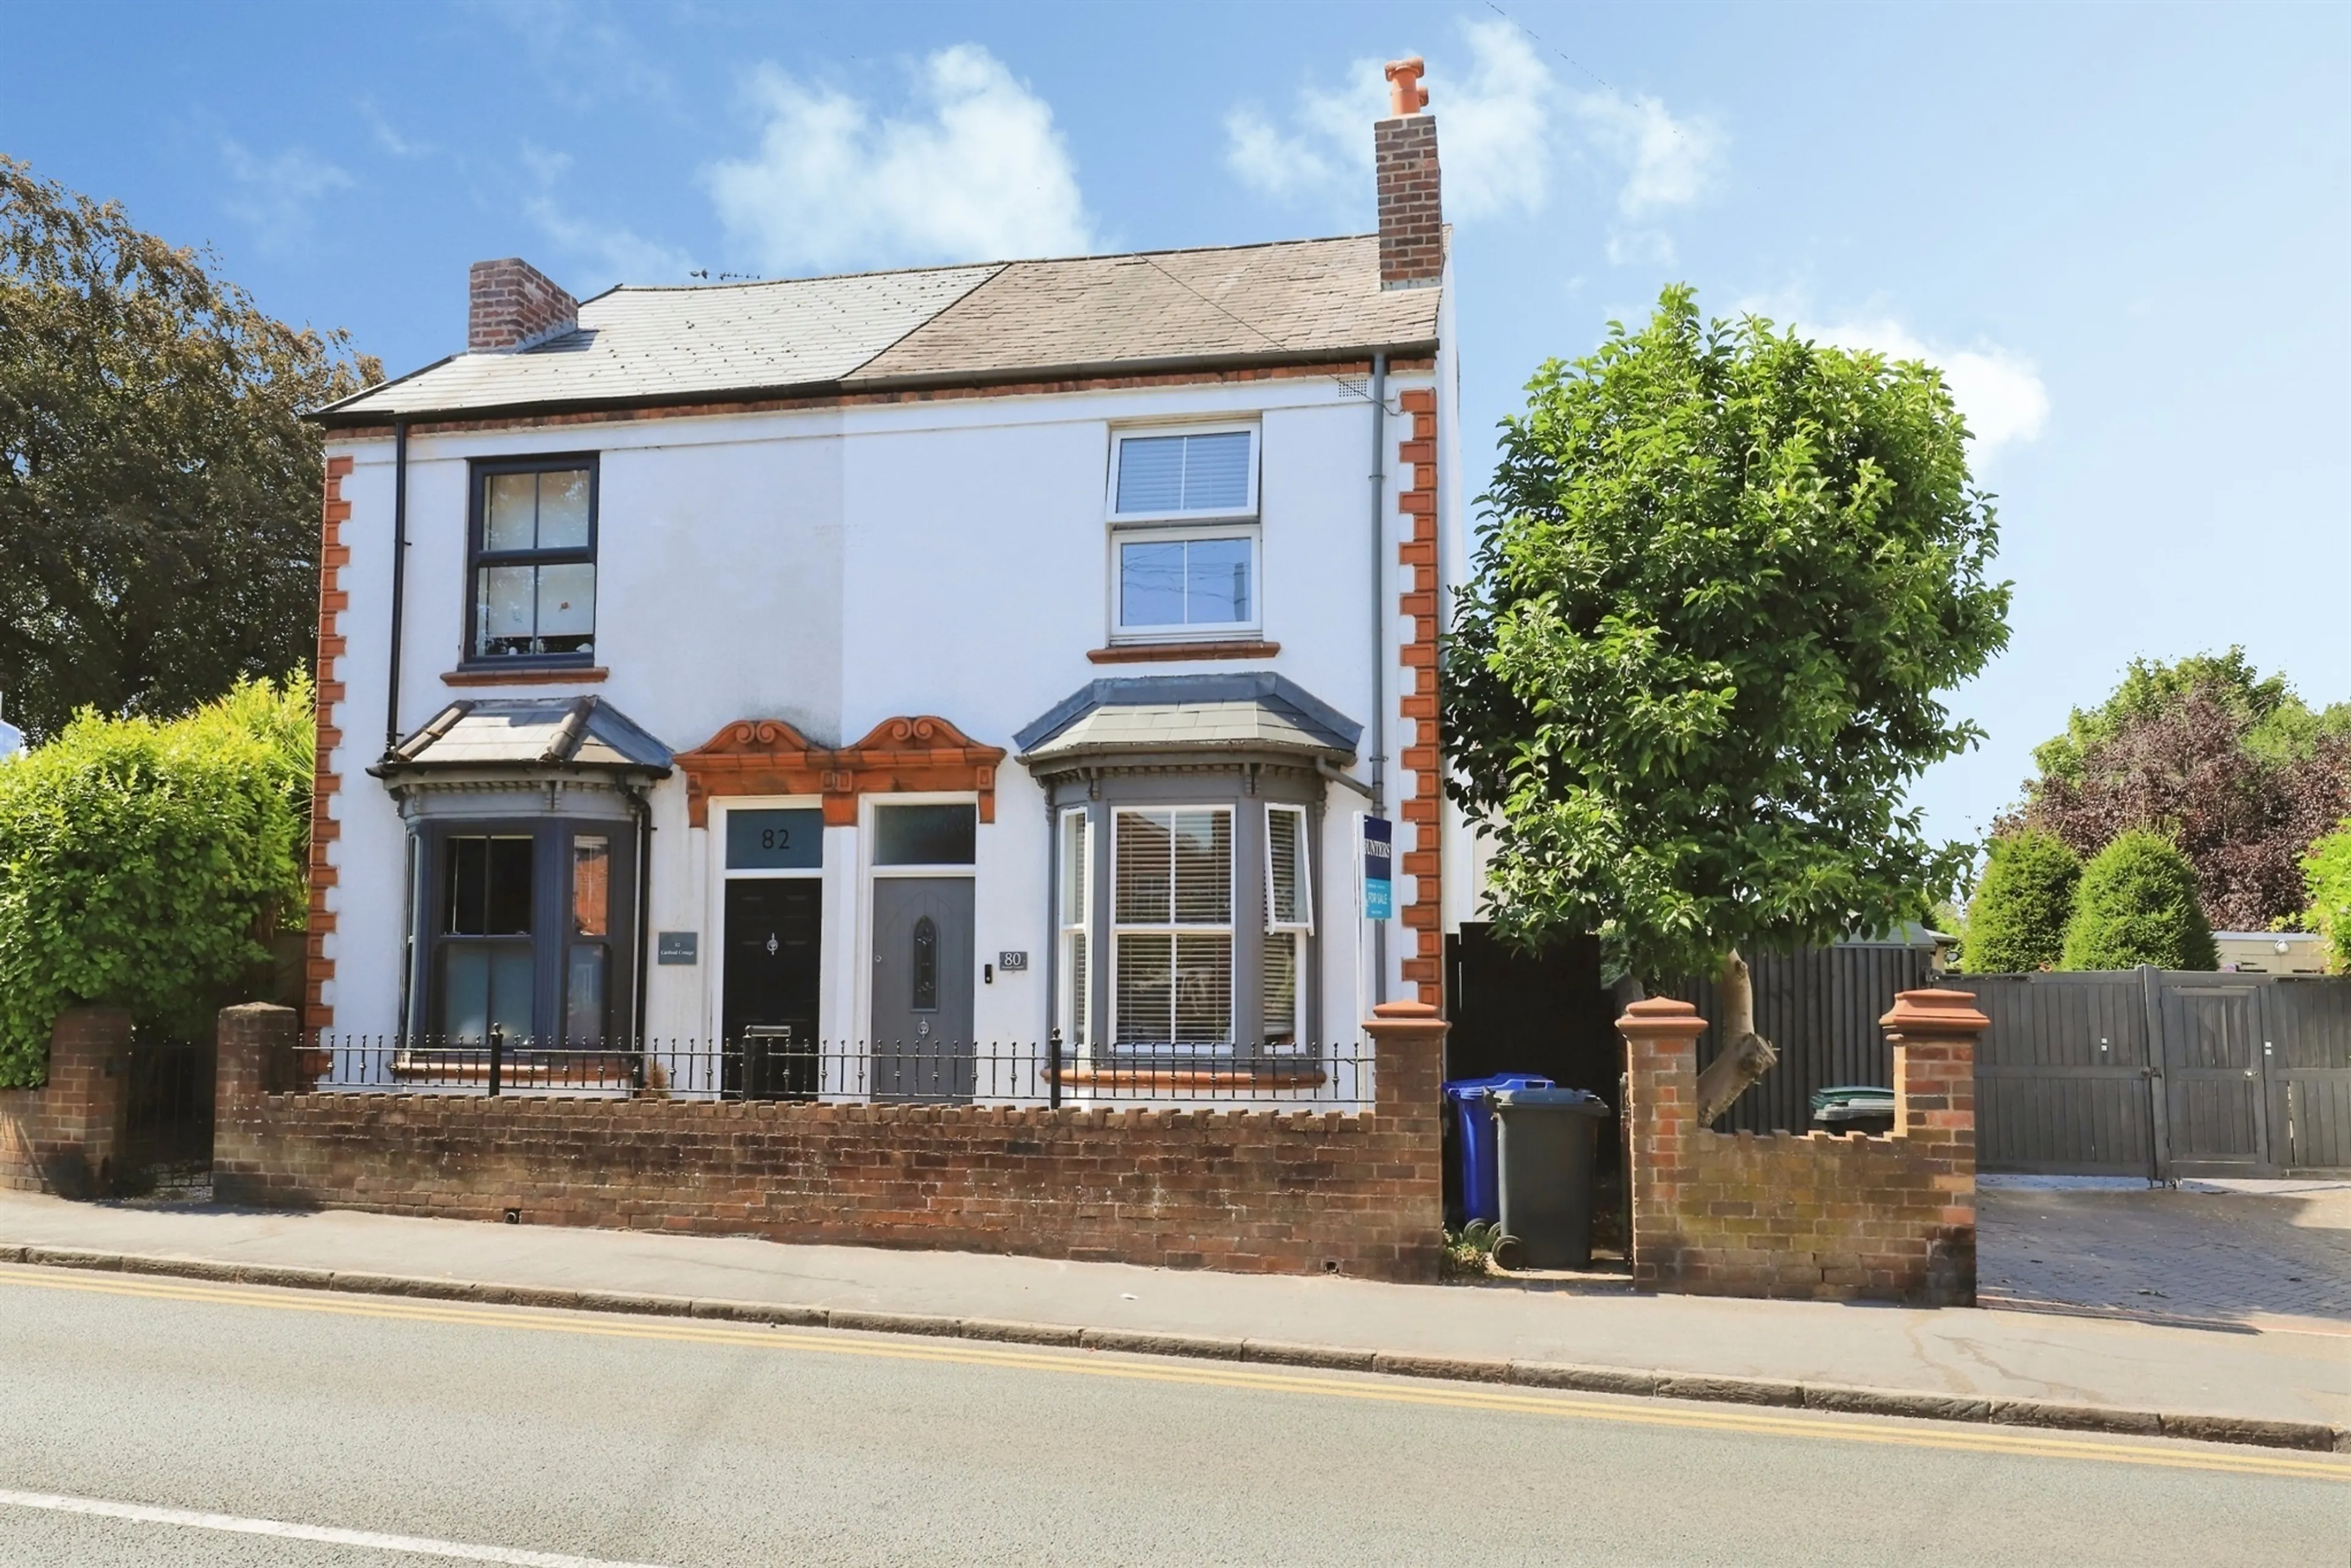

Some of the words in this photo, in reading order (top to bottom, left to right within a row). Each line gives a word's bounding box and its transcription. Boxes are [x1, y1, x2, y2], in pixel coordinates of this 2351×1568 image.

[762, 829, 790, 849] 82
[1378, 893, 1388, 904] SALE
[1005, 953, 1021, 966] 80
